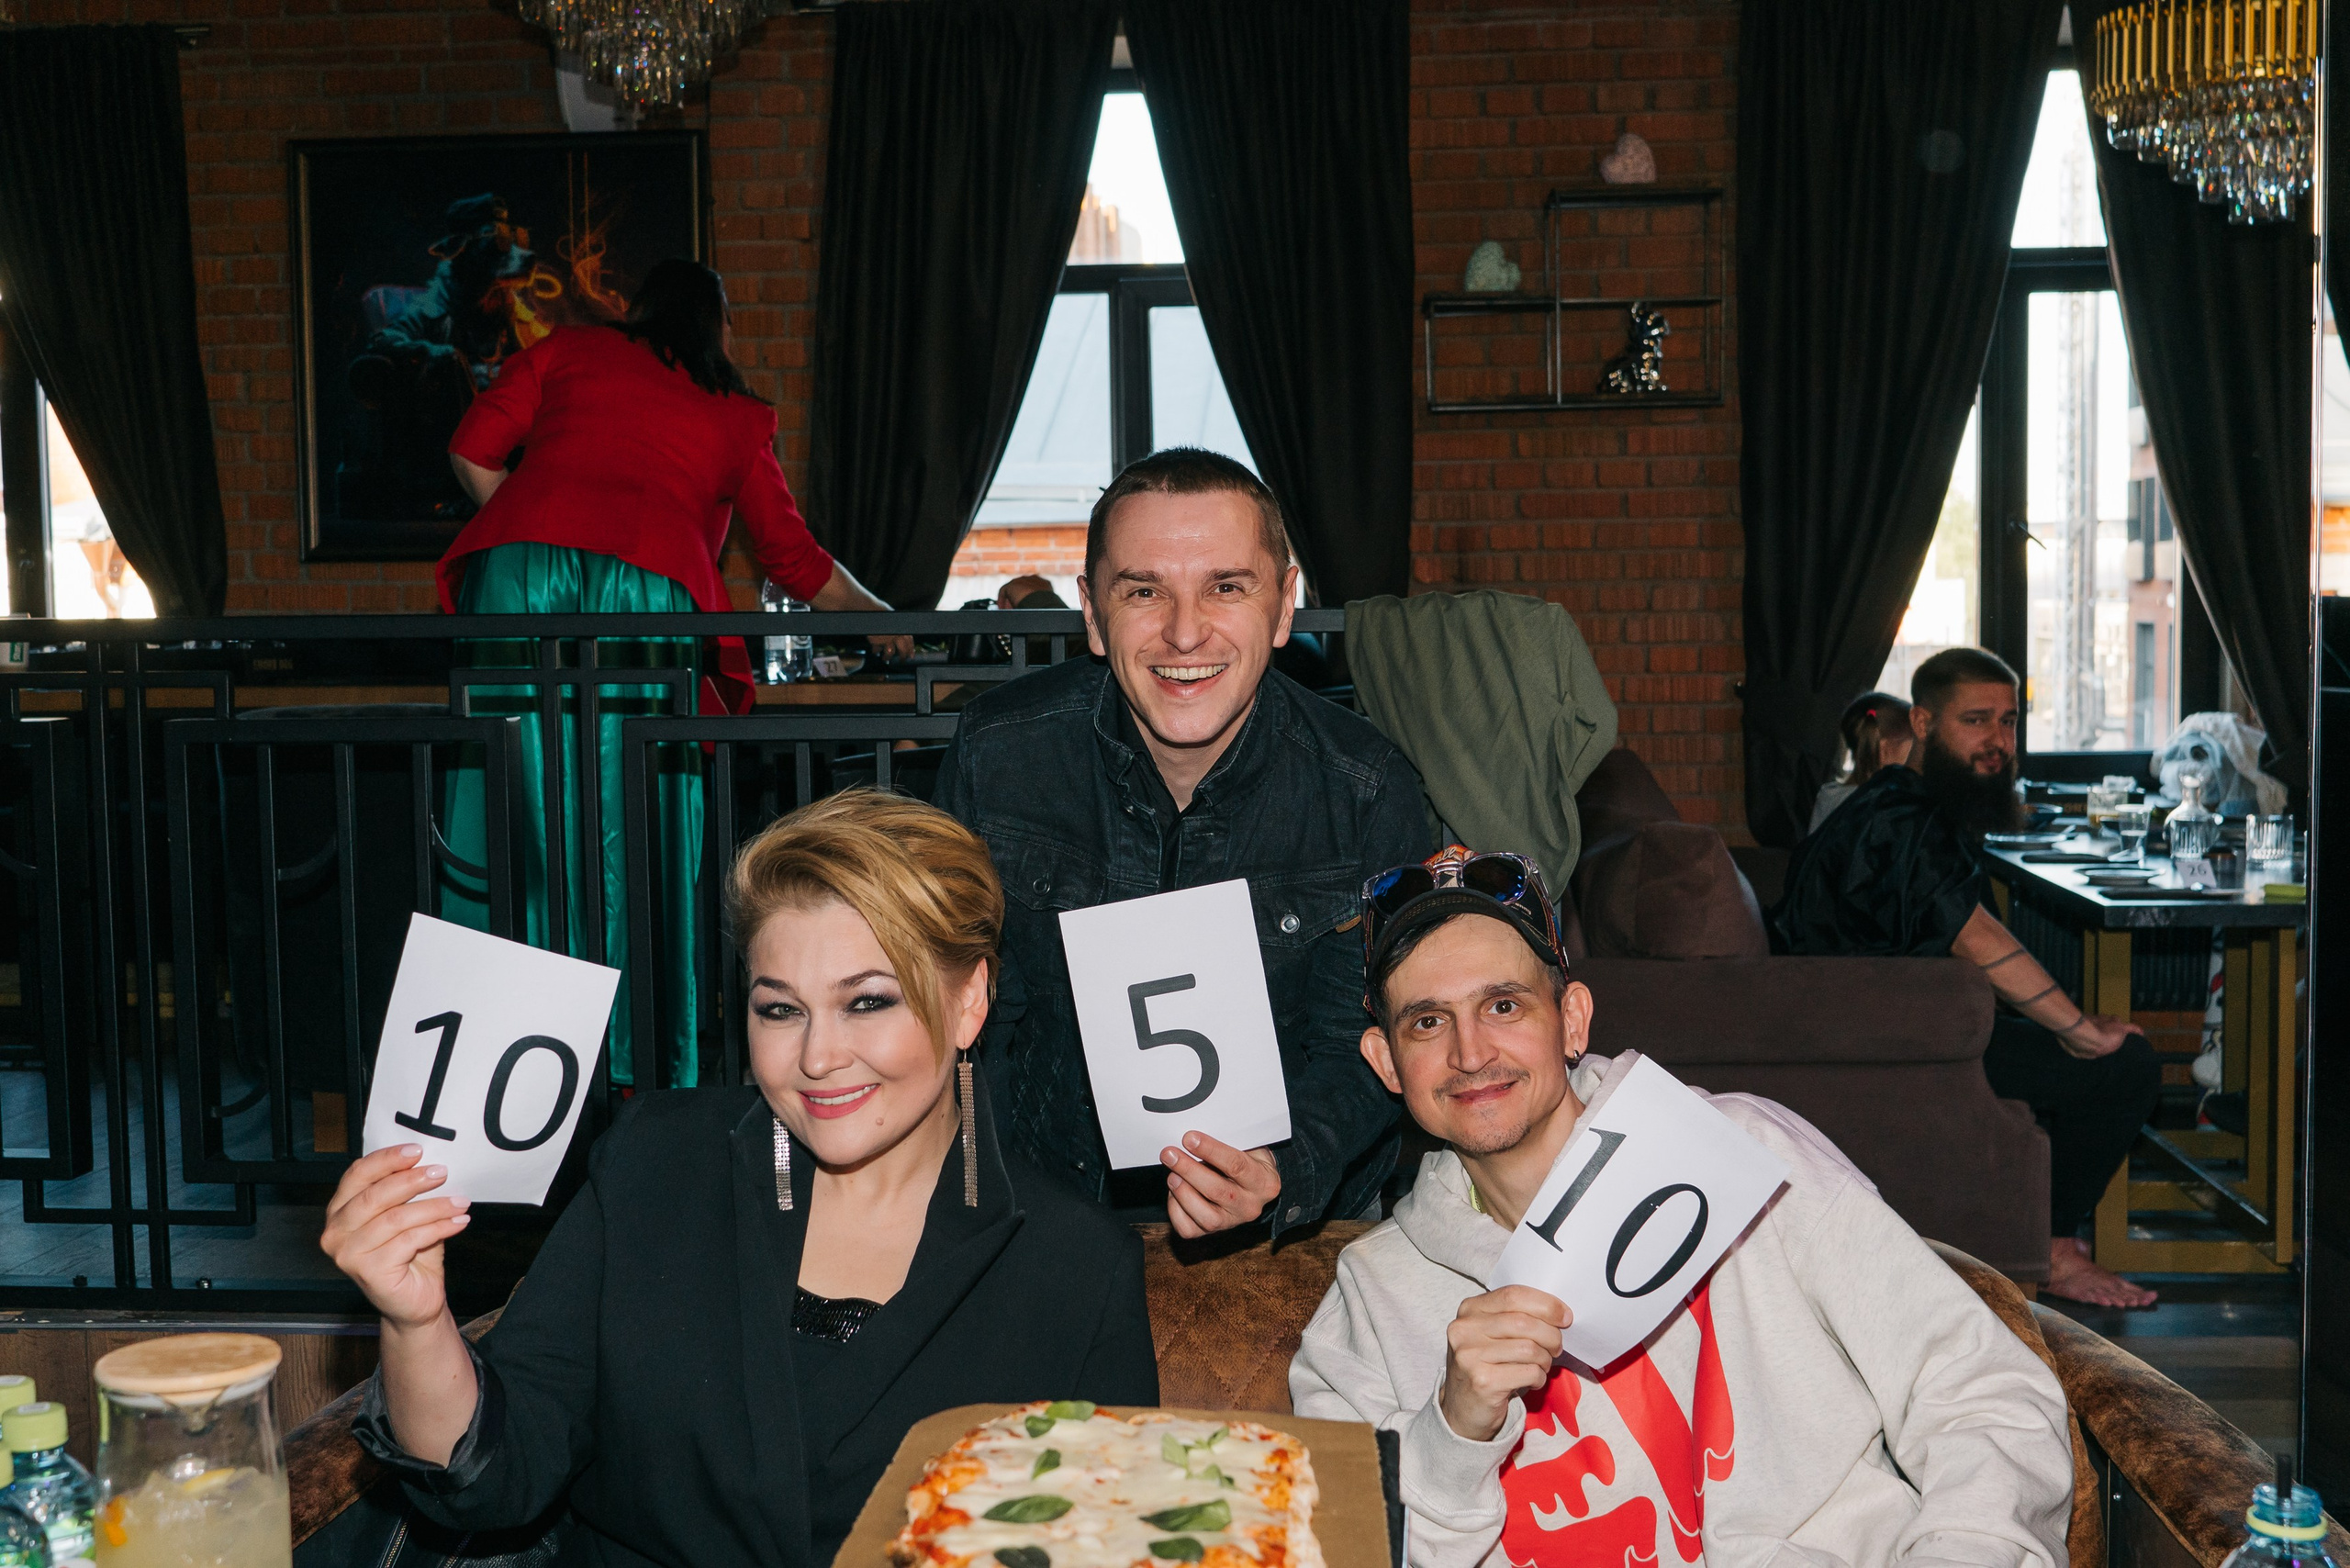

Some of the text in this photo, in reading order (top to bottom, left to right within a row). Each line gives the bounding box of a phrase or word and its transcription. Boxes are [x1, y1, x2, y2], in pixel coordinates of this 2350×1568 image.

[2187, 863, 2207, 877] 26
[394, 1011, 579, 1152] 10
[1127, 973, 1220, 1114] 5
[1525, 1126, 1709, 1299] 10
